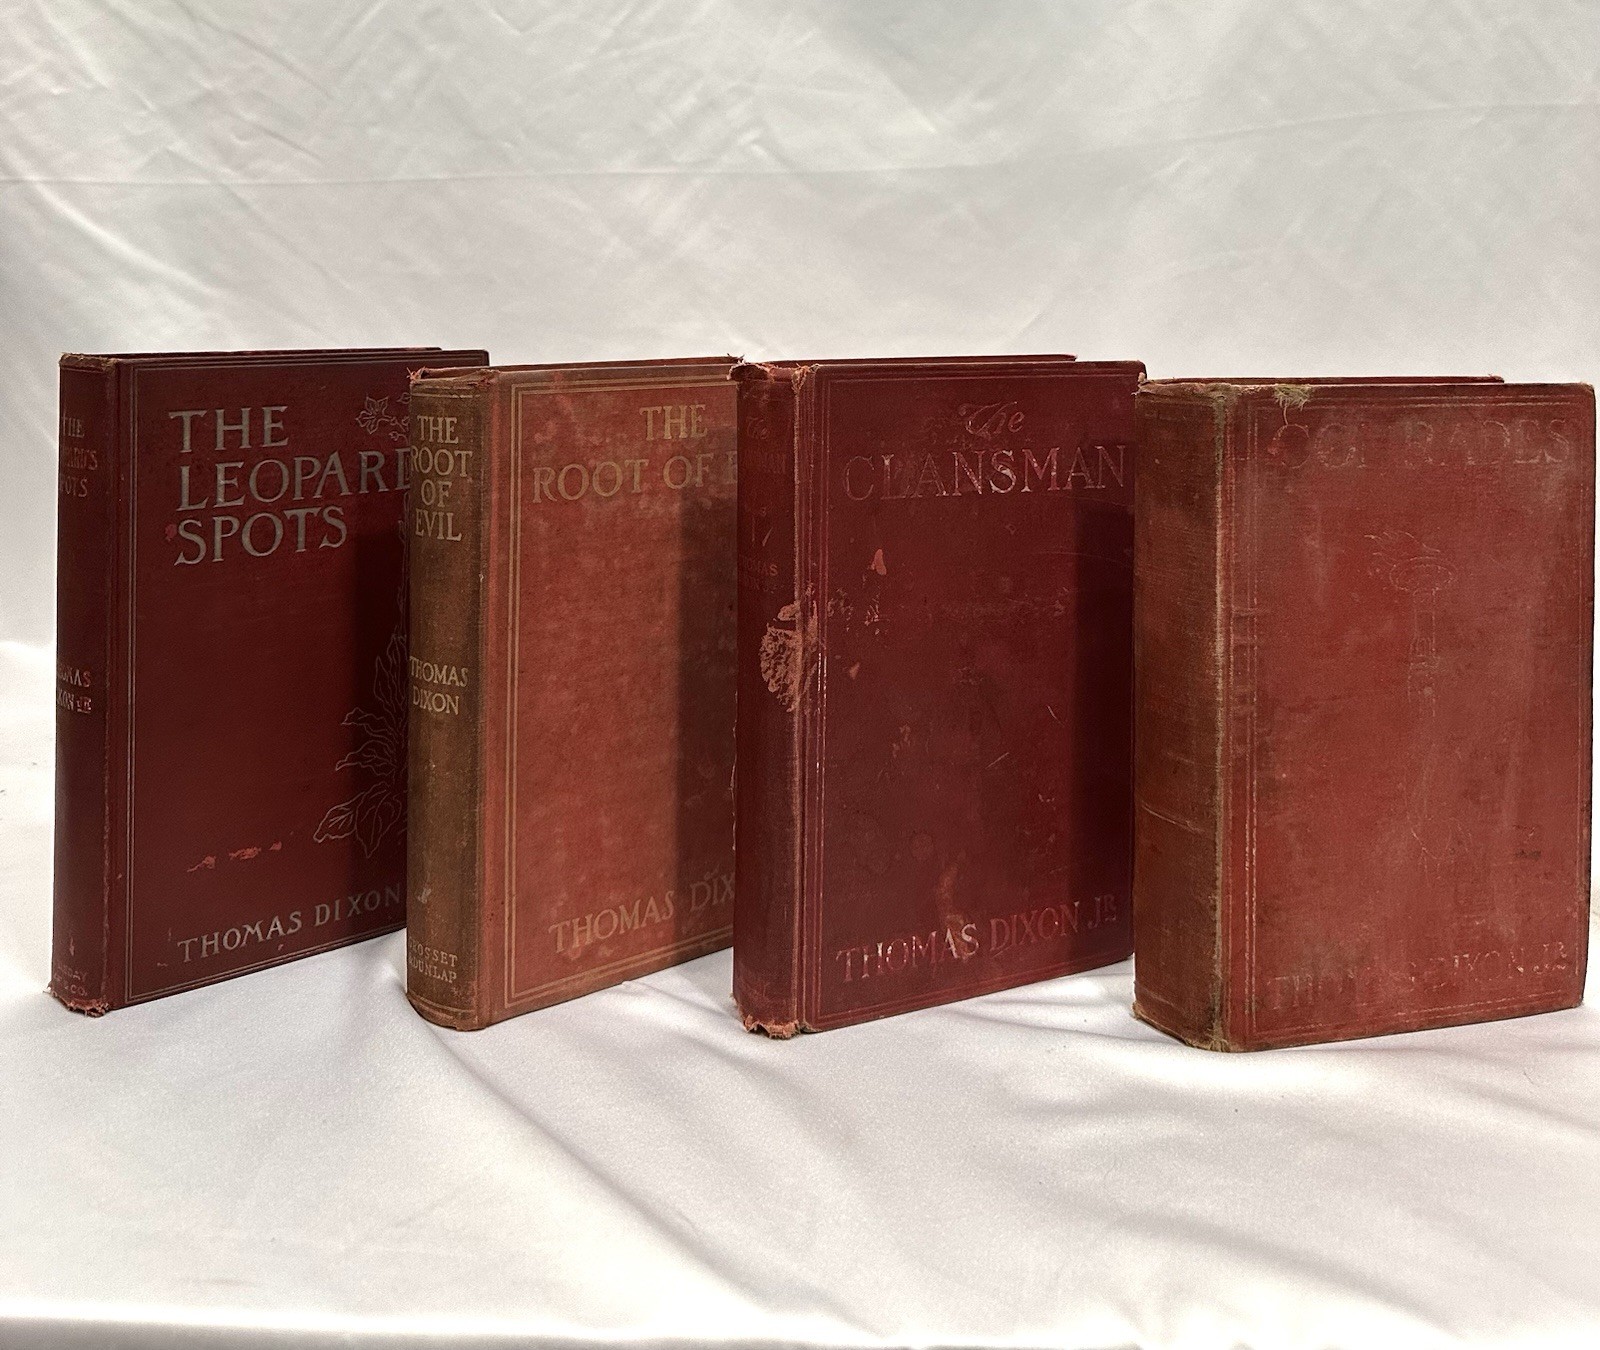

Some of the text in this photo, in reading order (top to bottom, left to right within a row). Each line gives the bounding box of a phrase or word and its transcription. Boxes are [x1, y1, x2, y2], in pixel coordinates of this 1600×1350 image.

[168, 404, 290, 453] THE
[417, 414, 459, 445] THE
[639, 403, 708, 442] THE
[957, 401, 1025, 440] The
[409, 445, 474, 479] ROOT
[531, 458, 650, 504] ROOT
[662, 452, 715, 490] OF
[843, 444, 1127, 502] CLANSMAN
[420, 480, 453, 508] OF
[173, 505, 348, 566] SPOTS
[414, 508, 463, 542] EVIL
[409, 656, 469, 688] THOMAS
[412, 685, 460, 715] DIXON
[176, 884, 402, 964] THOMAS DIXON
[547, 890, 676, 954] THOMAS
[835, 923, 981, 984] THOMAS
[989, 900, 1081, 957] DIXON
